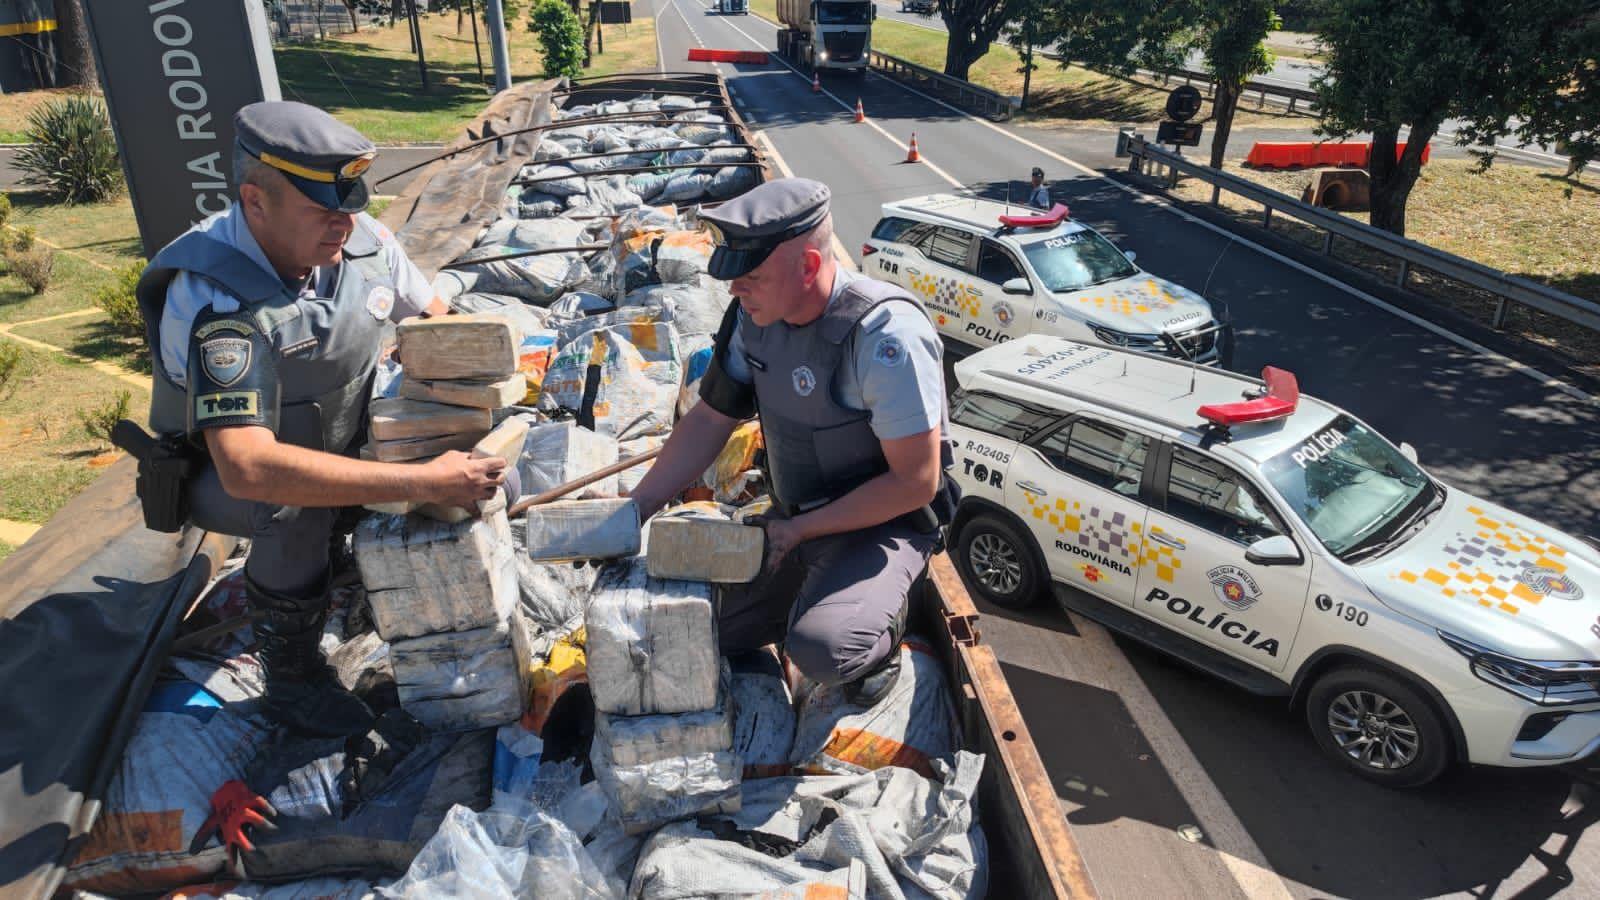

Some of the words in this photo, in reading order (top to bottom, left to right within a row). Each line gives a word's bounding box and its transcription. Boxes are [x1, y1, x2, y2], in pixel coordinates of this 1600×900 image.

[186, 151, 232, 225] CIA
[880, 259, 899, 274] TOR
[203, 396, 249, 413] TOR
[966, 440, 1011, 464] R-02405
[1291, 428, 1349, 469] POLÍCIA
[963, 457, 1003, 490] TOR
[1145, 587, 1281, 658] POLÍCIA
[1335, 601, 1369, 627] 190
